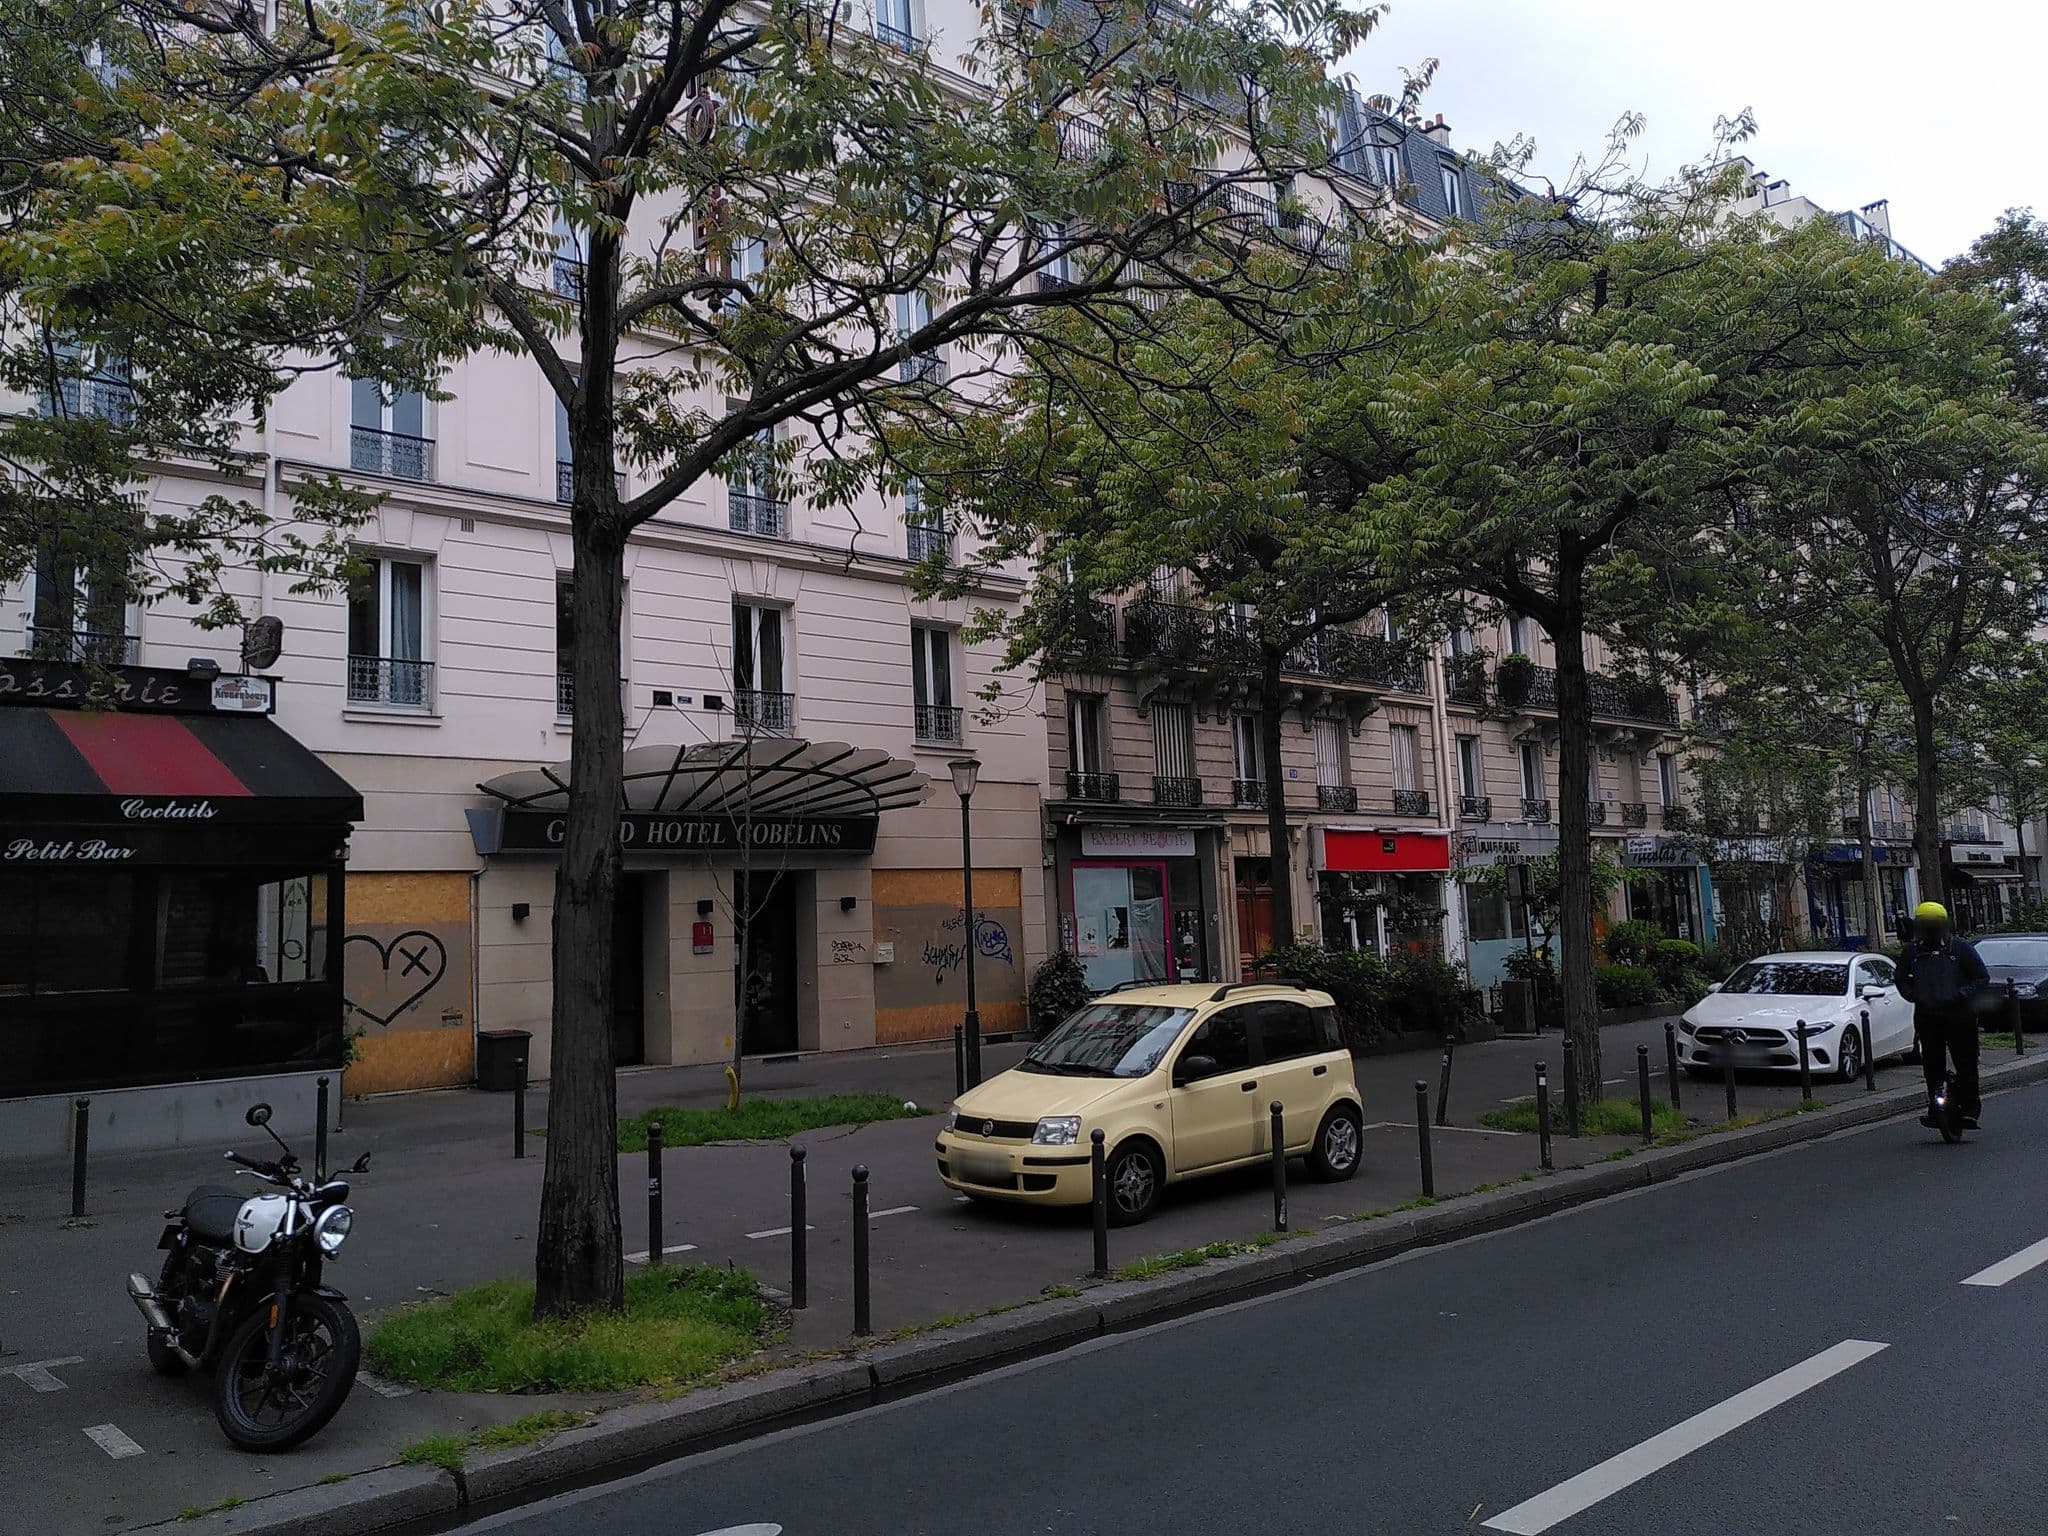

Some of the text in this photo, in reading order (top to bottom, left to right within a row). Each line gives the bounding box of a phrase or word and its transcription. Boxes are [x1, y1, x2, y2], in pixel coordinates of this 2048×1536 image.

[214, 687, 268, 705] Kronenbourg
[120, 799, 219, 819] Coctails
[647, 821, 726, 844] HOTEL
[4, 839, 137, 860] Petit Bar
